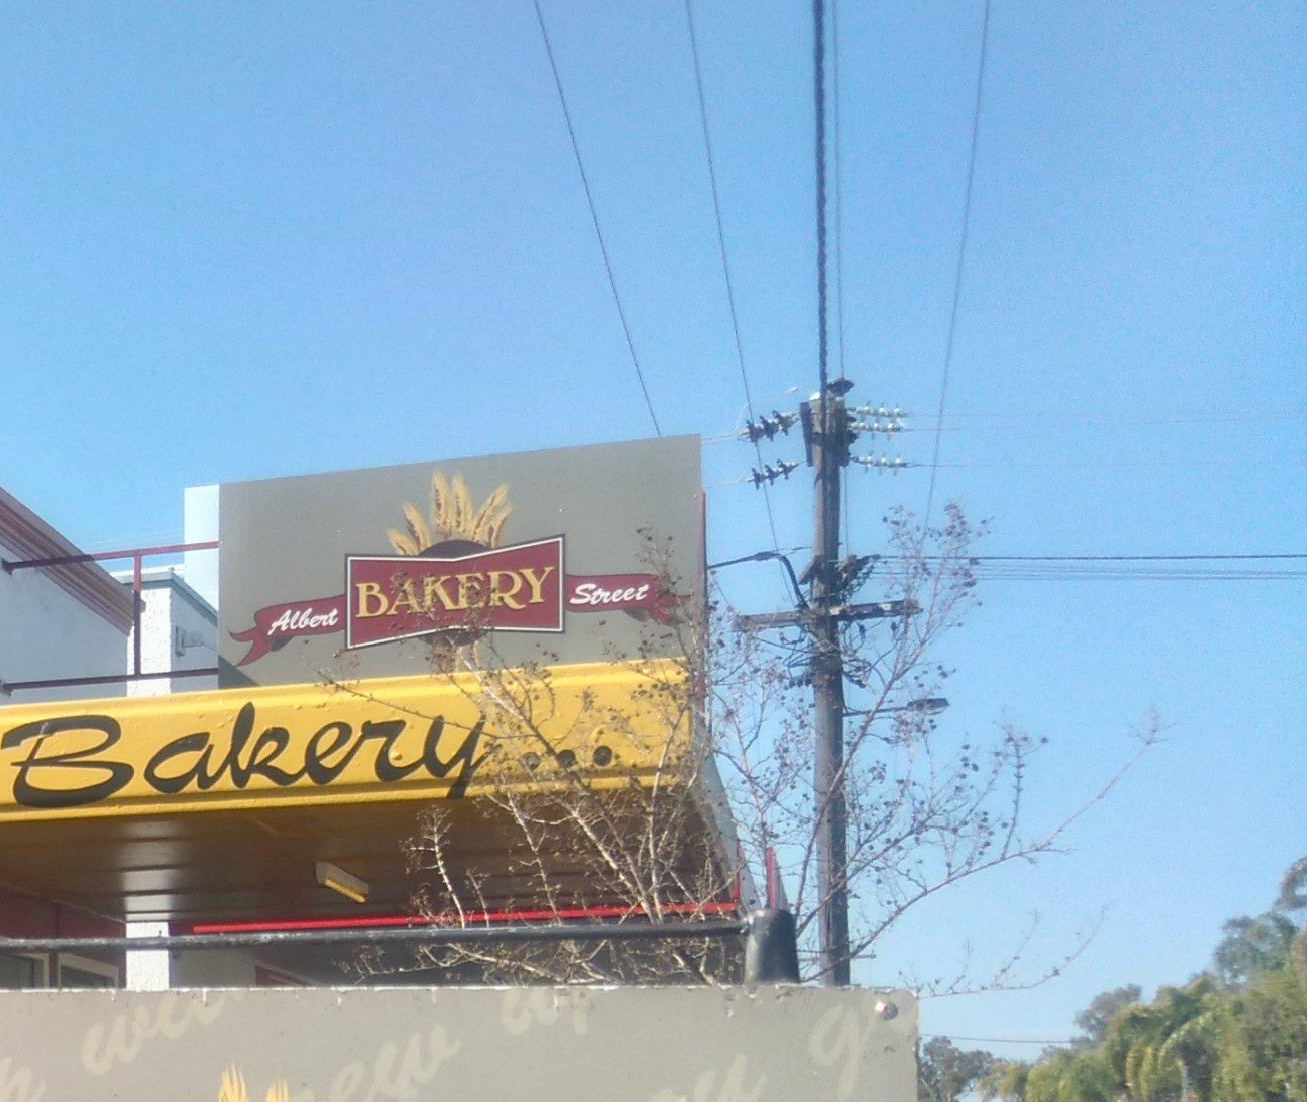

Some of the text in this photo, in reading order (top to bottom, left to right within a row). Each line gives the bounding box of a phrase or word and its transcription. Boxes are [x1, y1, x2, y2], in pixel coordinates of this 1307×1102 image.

[267, 566, 650, 636] Albert BAKERY Street
